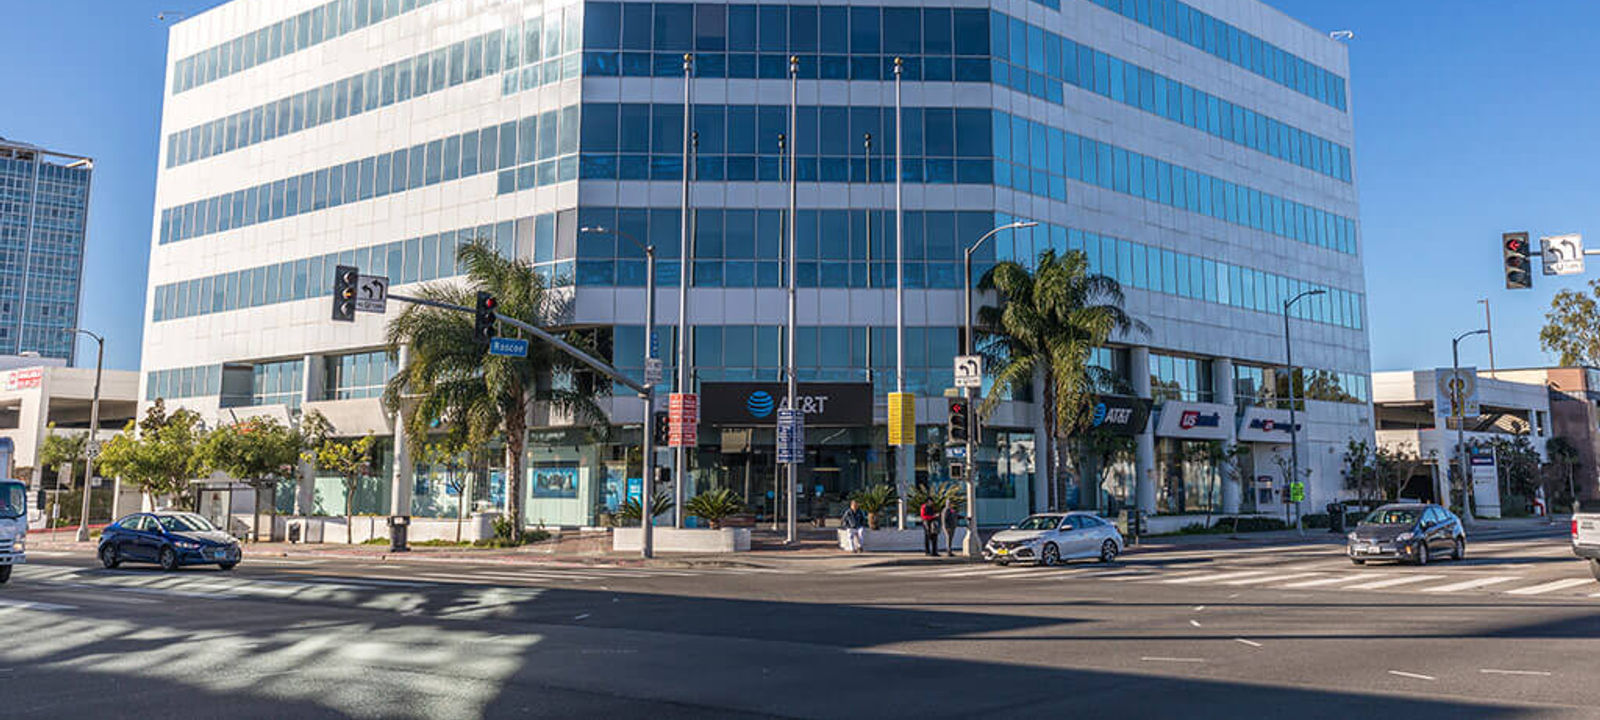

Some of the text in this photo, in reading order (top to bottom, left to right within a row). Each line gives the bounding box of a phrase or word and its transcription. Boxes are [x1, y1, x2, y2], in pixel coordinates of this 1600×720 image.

[494, 341, 524, 353] Roscoe
[780, 396, 828, 413] AT&T
[1105, 408, 1132, 424] AT&T
